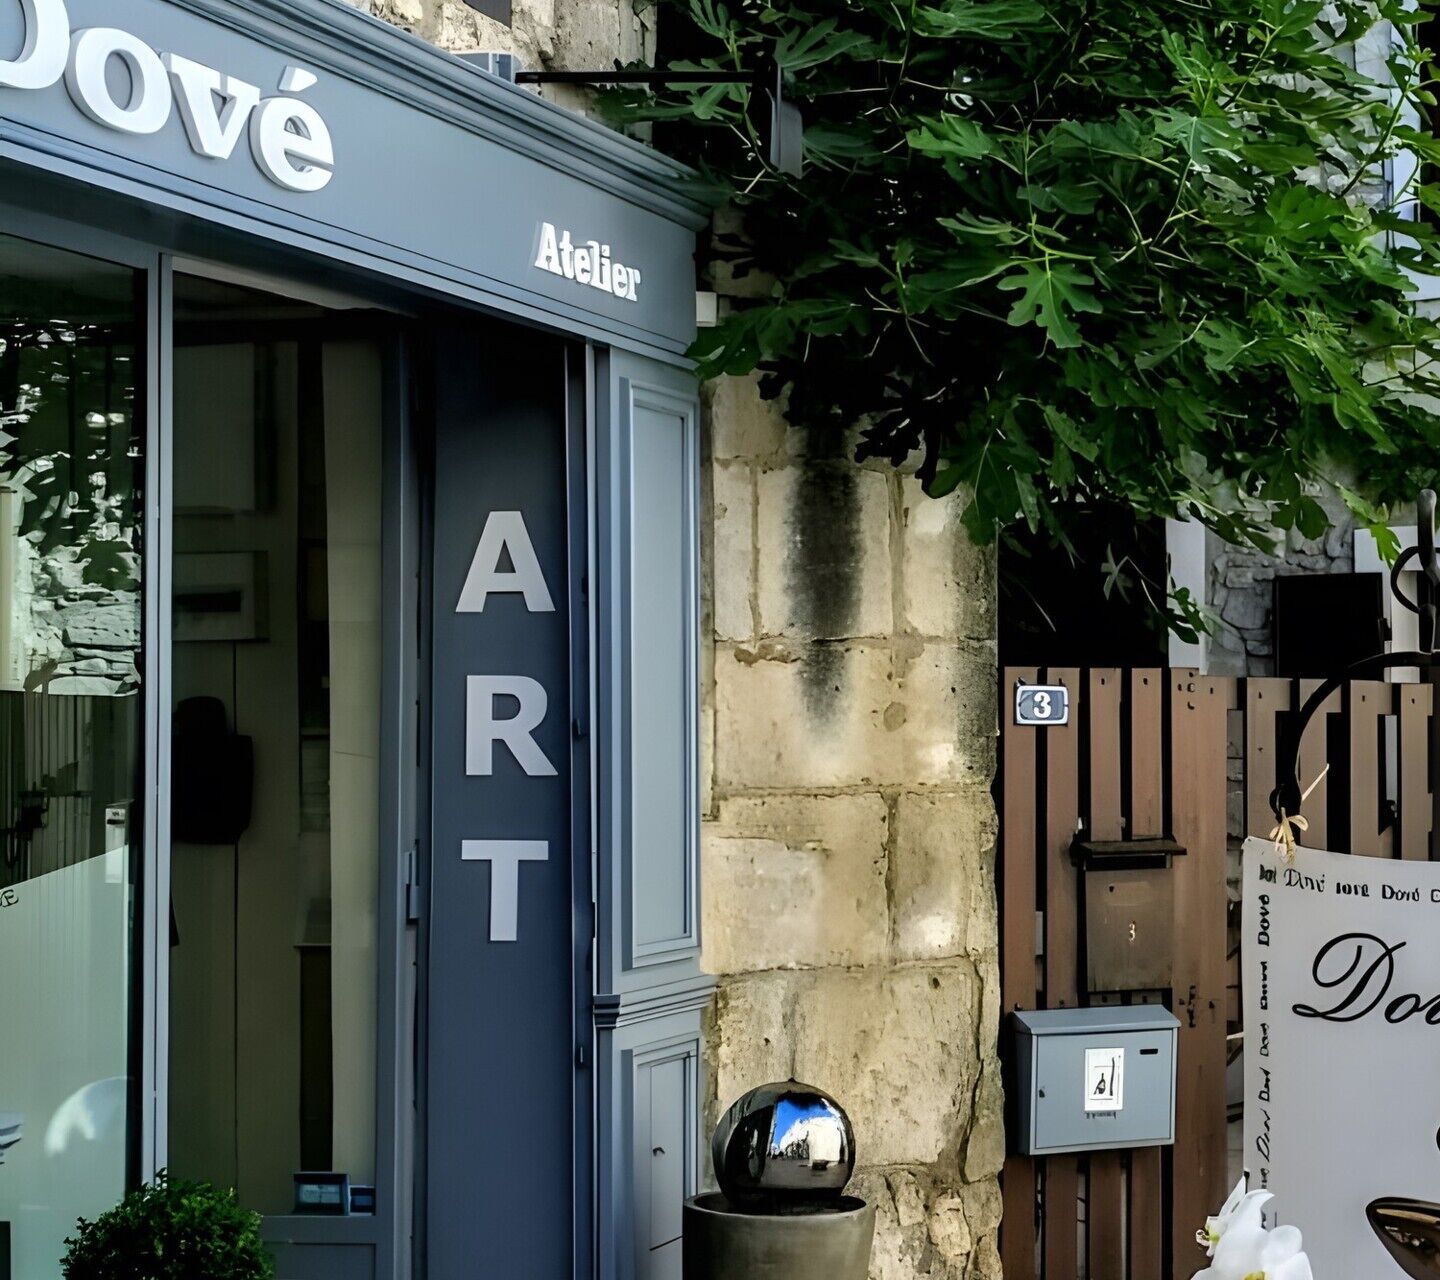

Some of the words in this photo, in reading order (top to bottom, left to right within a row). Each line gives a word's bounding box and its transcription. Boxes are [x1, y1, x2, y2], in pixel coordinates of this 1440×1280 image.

[534, 221, 641, 302] Atelier
[455, 510, 558, 941] ART
[1033, 692, 1052, 719] 3
